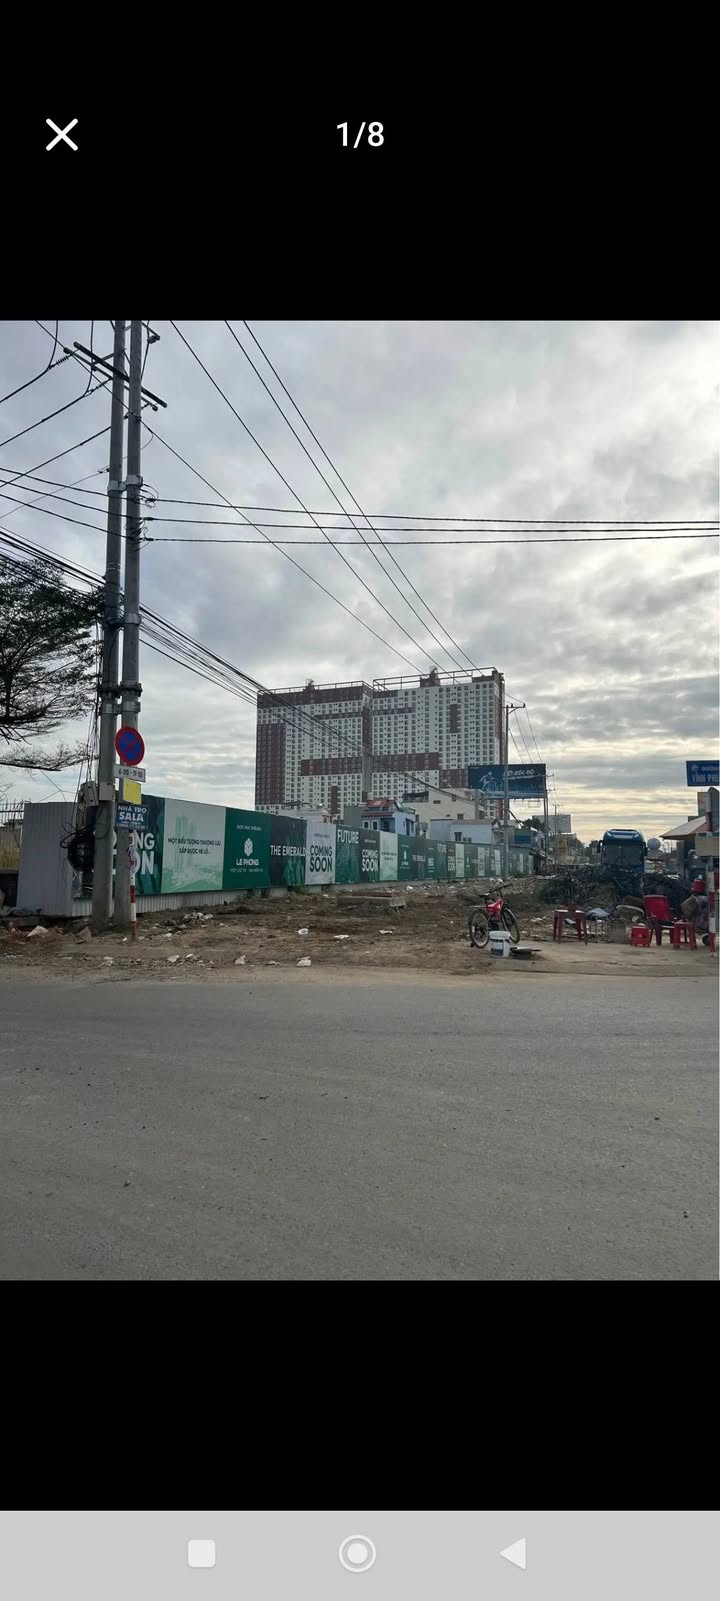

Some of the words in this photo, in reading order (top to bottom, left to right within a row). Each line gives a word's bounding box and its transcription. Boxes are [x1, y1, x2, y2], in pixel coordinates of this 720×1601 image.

[119, 812, 143, 822] SALA
[337, 829, 359, 844] FUTURE
[270, 844, 282, 856] THE
[282, 845, 306, 857] EMERALD
[310, 845, 332, 857] COMING
[362, 848, 379, 859] COMING
[243, 858, 260, 866] PHONG
[310, 857, 332, 873] SOON
[362, 858, 379, 872] SOON
